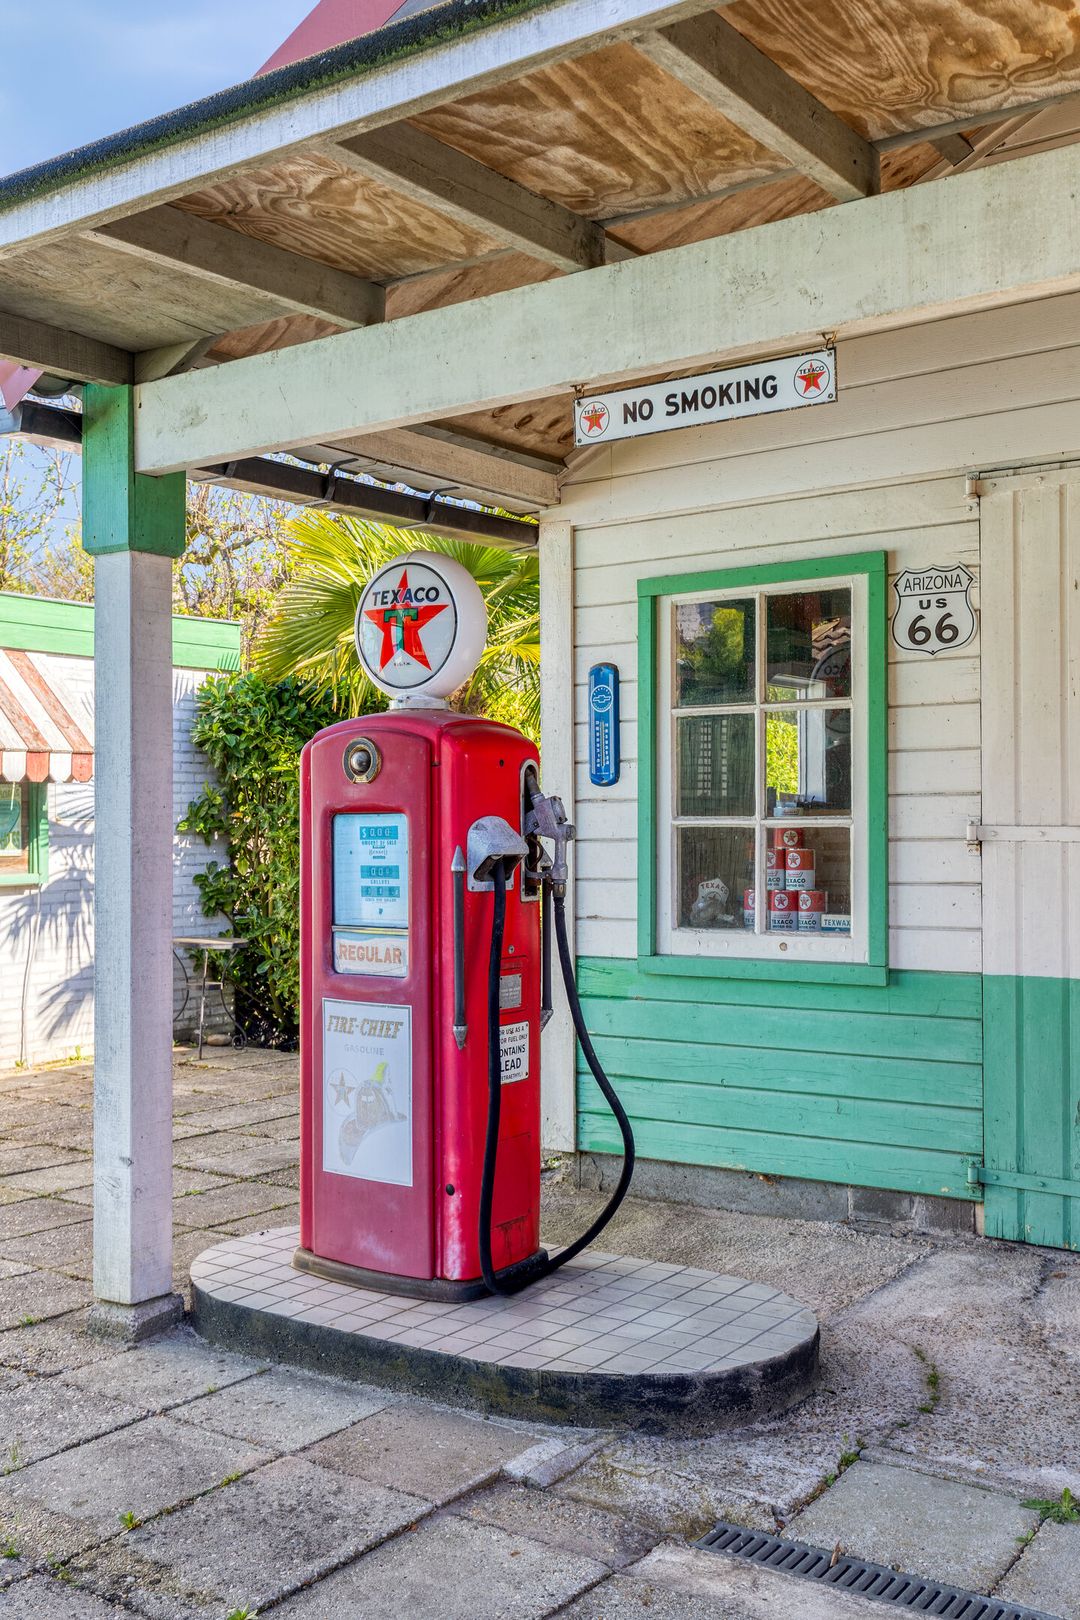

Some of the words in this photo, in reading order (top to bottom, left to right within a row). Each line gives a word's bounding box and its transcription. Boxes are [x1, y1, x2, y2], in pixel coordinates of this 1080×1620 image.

[799, 365, 825, 375] TEXACO
[622, 398, 654, 424] NO
[665, 375, 778, 417] SMOKING
[584, 407, 606, 416] TEXACO
[903, 574, 963, 592] ARIZONA
[372, 586, 440, 607] TEXACO
[918, 598, 948, 610] US
[907, 612, 959, 646] 66
[700, 882, 729, 895] TEXACO
[824, 919, 851, 927] TEXWAX
[338, 943, 403, 965] REGULAR
[327, 1015, 404, 1039] FIRE-CHIEF
[344, 1043, 385, 1056] GASOLINE
